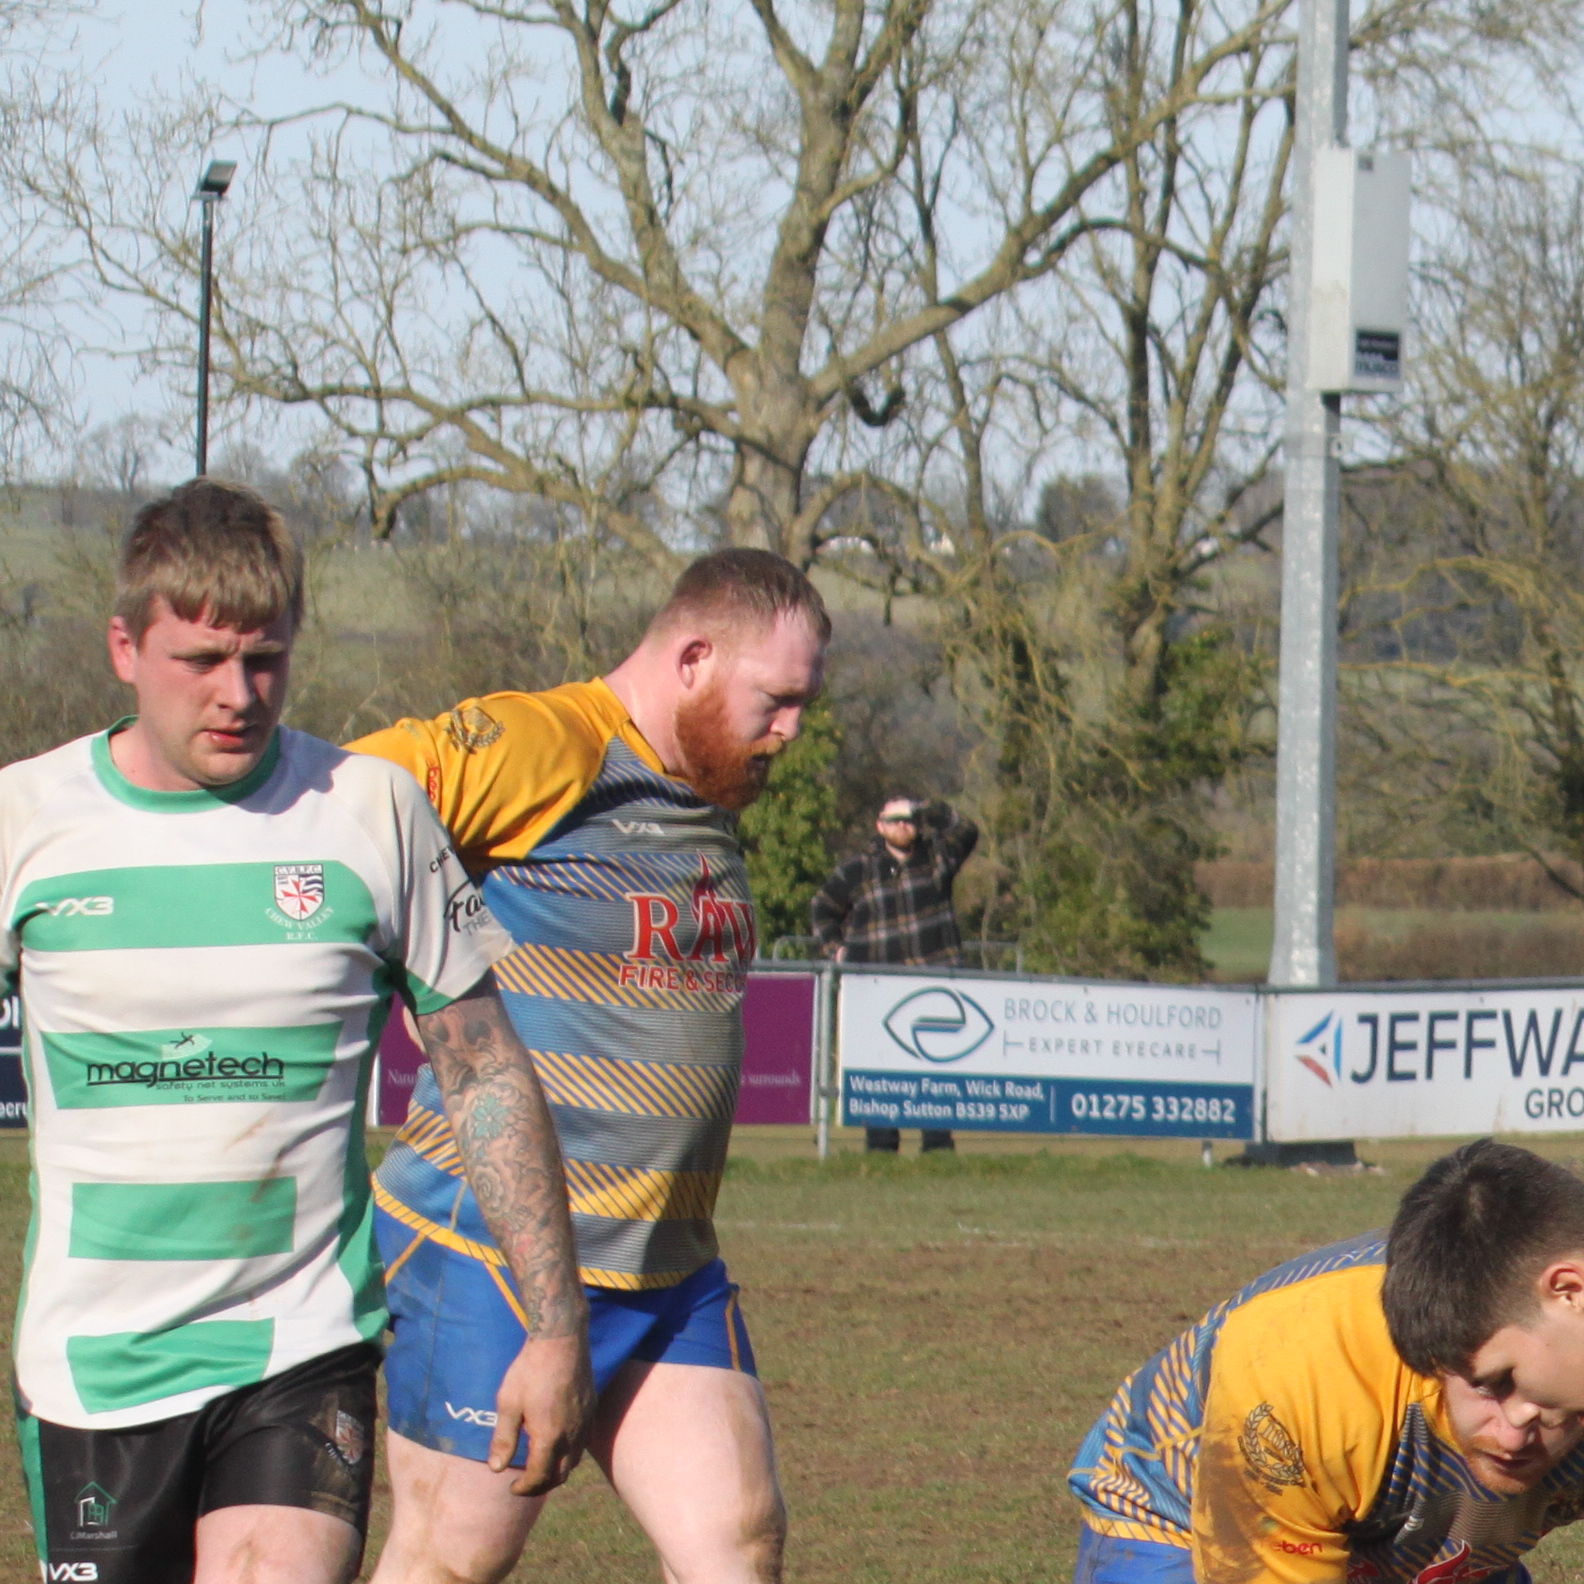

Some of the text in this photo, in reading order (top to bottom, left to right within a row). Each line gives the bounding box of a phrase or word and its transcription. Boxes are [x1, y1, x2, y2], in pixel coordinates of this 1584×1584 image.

[618, 964, 680, 991] FIRE
[684, 969, 700, 991] &
[1003, 998, 1222, 1029] BROCK & HOULFORD
[1028, 1036, 1197, 1058] EXPERT EYECARE
[87, 1051, 285, 1088] magnetech
[849, 1075, 1044, 1100] Westway Farm, Wick Road,
[849, 1099, 899, 1120] Bishop
[903, 1101, 952, 1118] Sutton
[955, 1102, 998, 1118] BS39
[1071, 1093, 1237, 1123] 01275 332882
[444, 1401, 499, 1427] VX3
[49, 1562, 99, 1582] VX3
